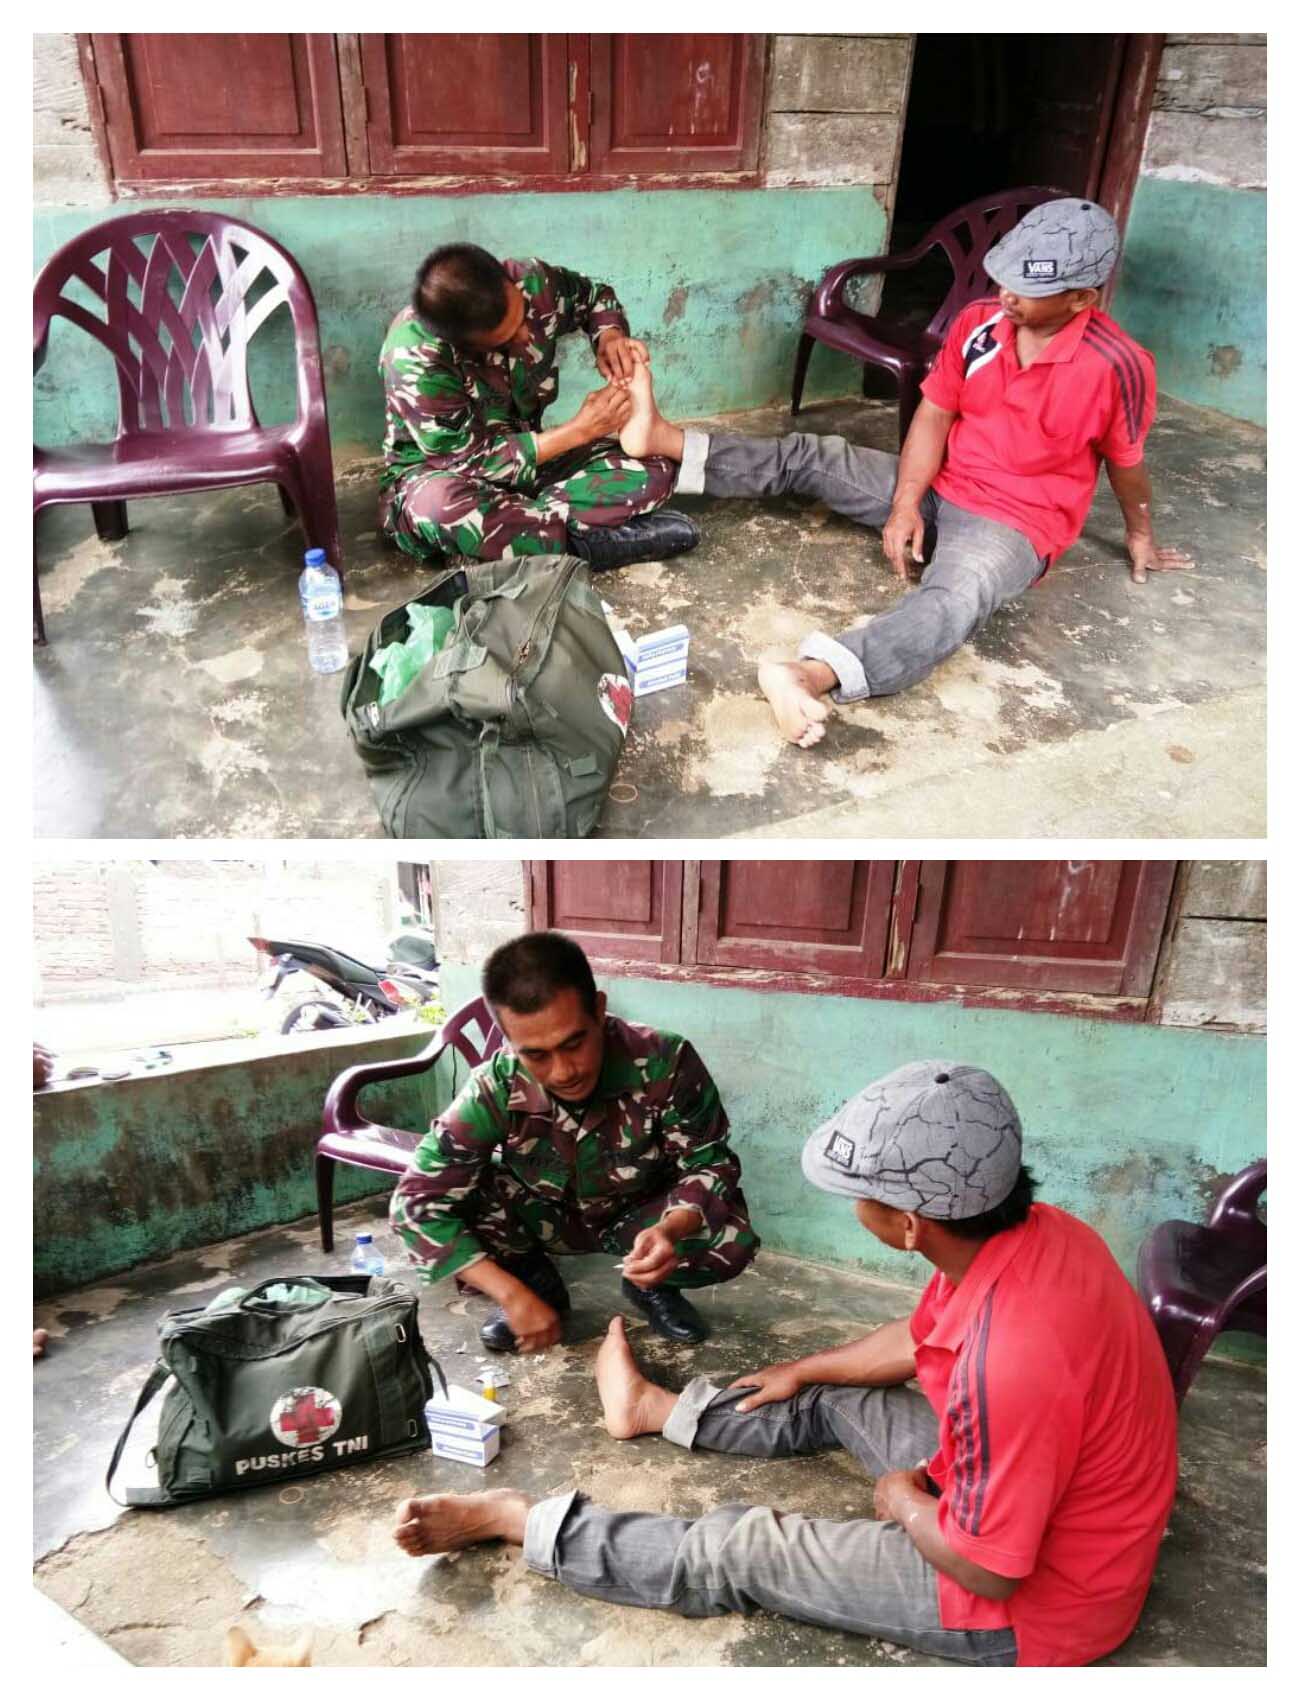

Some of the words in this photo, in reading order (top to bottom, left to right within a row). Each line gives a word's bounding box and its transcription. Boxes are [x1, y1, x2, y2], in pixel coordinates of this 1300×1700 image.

[1027, 261, 1055, 273] VANS
[235, 1446, 325, 1475] PUSKES
[332, 1435, 369, 1456] TNI
